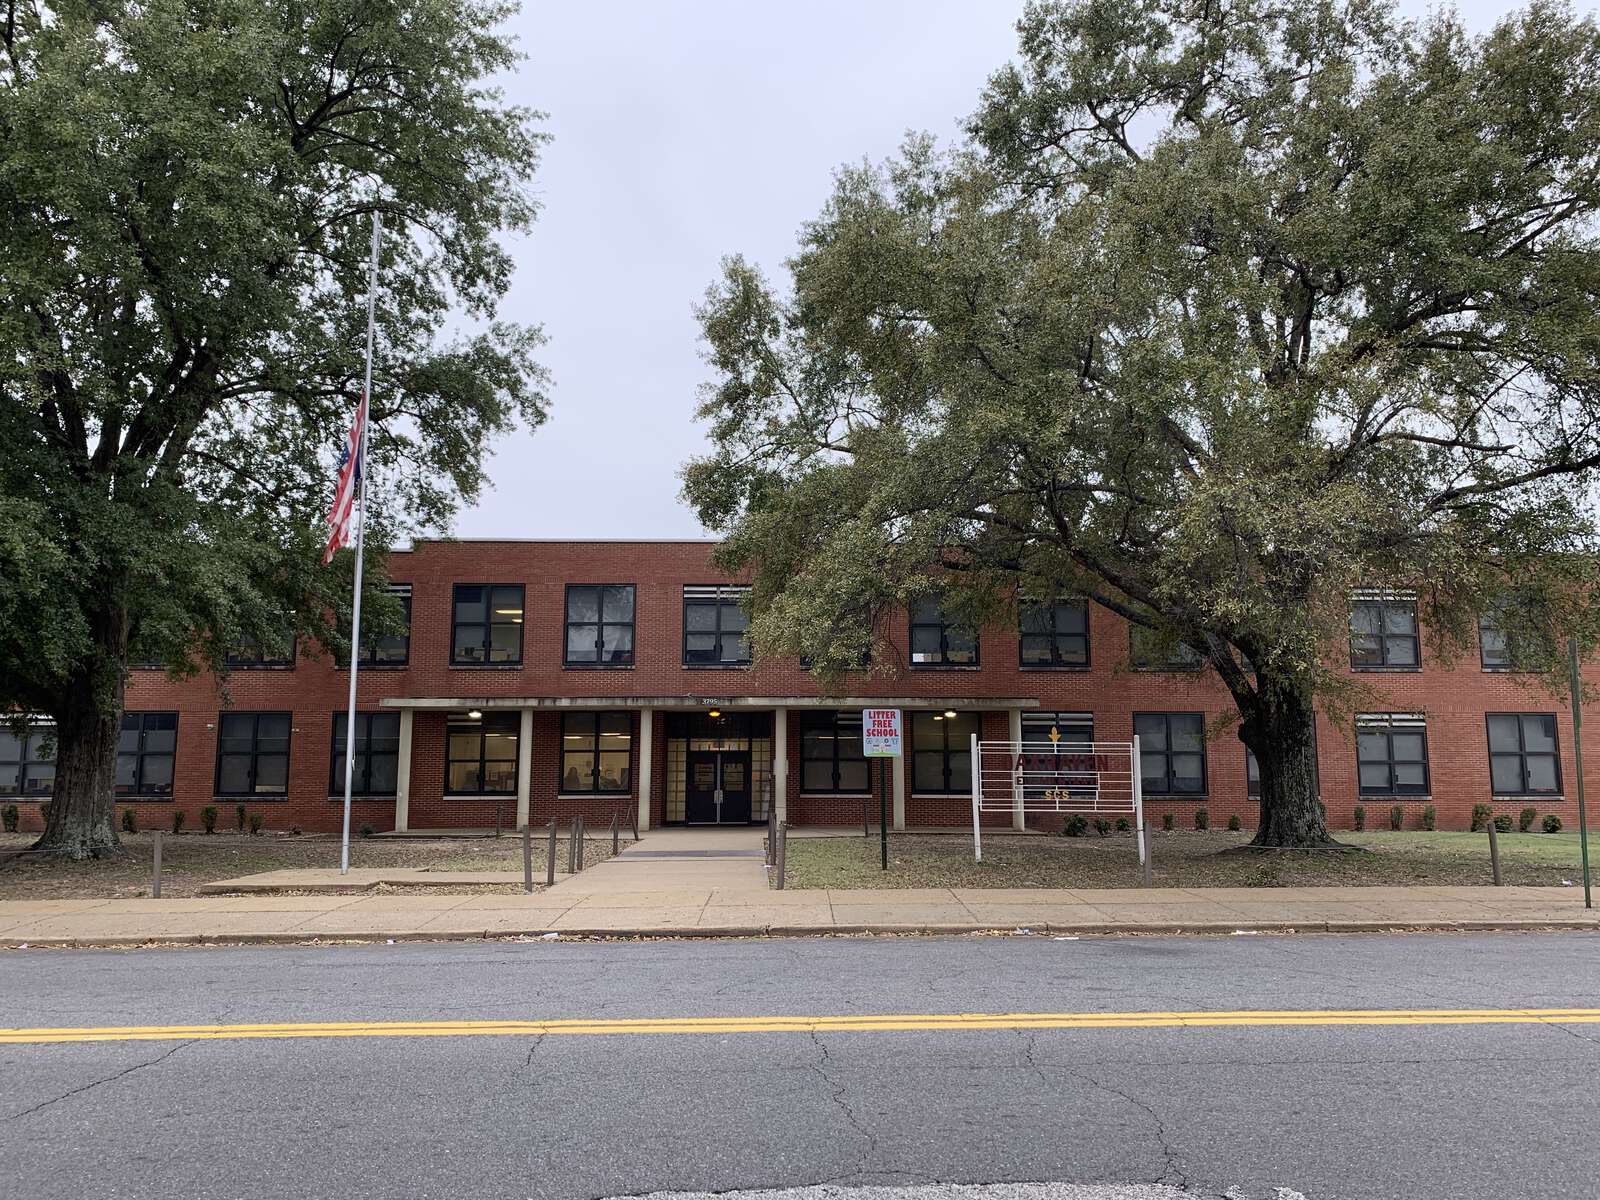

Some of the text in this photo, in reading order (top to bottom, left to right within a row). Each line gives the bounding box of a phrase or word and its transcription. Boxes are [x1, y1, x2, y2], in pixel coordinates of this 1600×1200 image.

[868, 711, 896, 719] LITTER
[872, 720, 893, 728] FREE
[866, 729, 899, 737] SCHOOL
[1044, 789, 1070, 800] SCS
